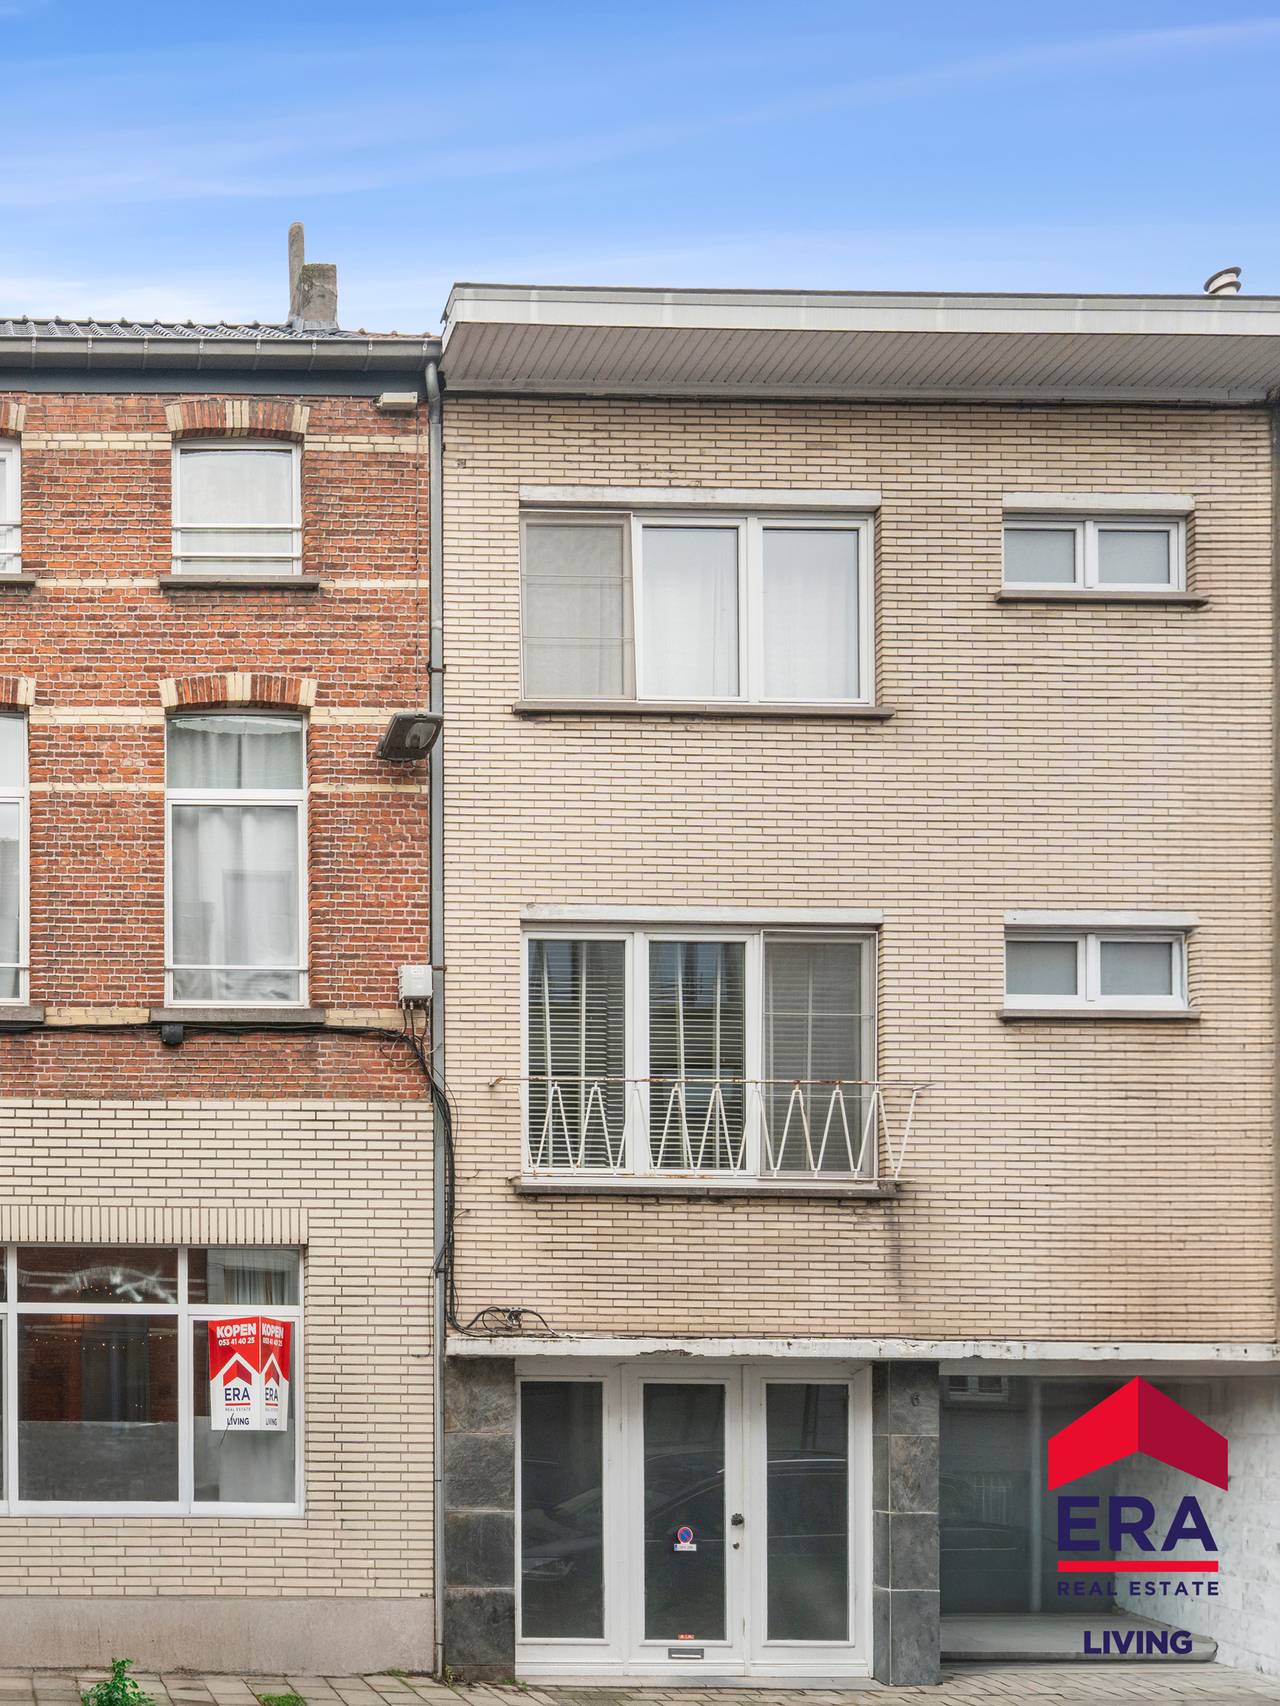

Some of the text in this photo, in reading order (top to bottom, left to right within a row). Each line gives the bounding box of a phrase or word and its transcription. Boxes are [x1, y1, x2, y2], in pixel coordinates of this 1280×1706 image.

[217, 1323, 256, 1338] KOPEN
[262, 1323, 284, 1339] KOPEN
[224, 1387, 251, 1401] ERA
[265, 1387, 279, 1402] ERA
[226, 1417, 250, 1425] LIVING
